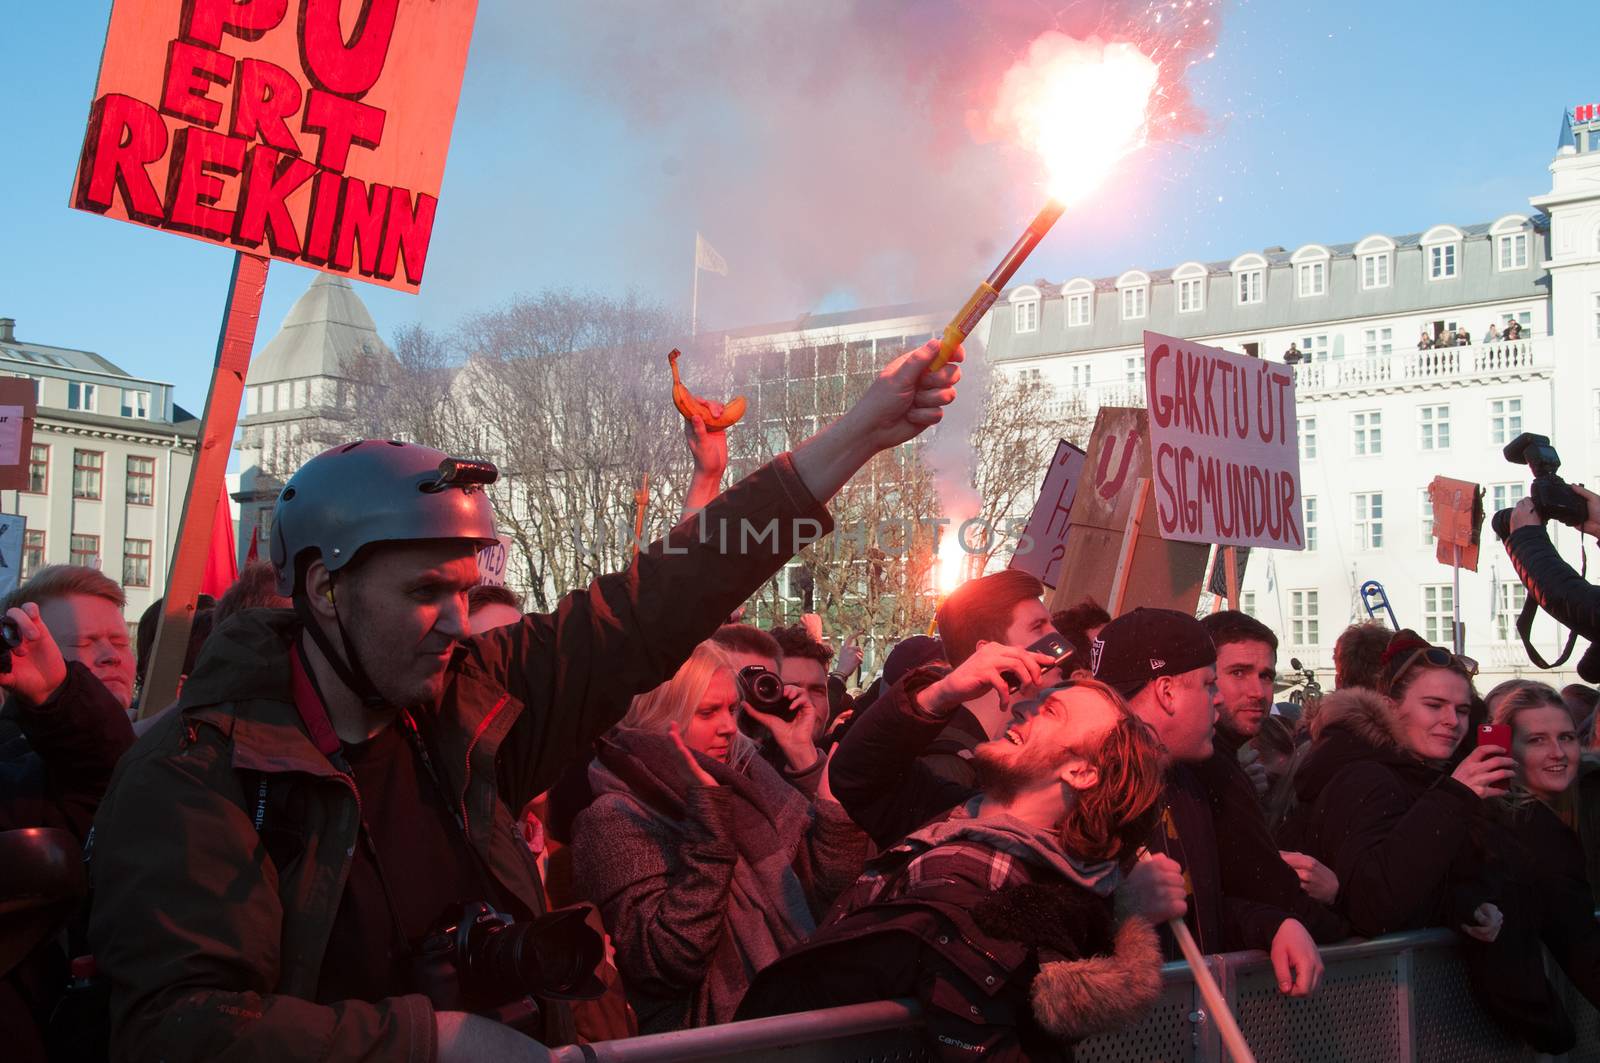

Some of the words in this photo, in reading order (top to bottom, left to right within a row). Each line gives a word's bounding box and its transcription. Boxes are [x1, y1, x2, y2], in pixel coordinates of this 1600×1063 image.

[159, 39, 387, 175] ERT
[1574, 103, 1600, 121] H
[76, 93, 438, 285] REKINN
[1151, 343, 1249, 440] GAKKTU
[1157, 442, 1301, 545] SIGMUNDUR
